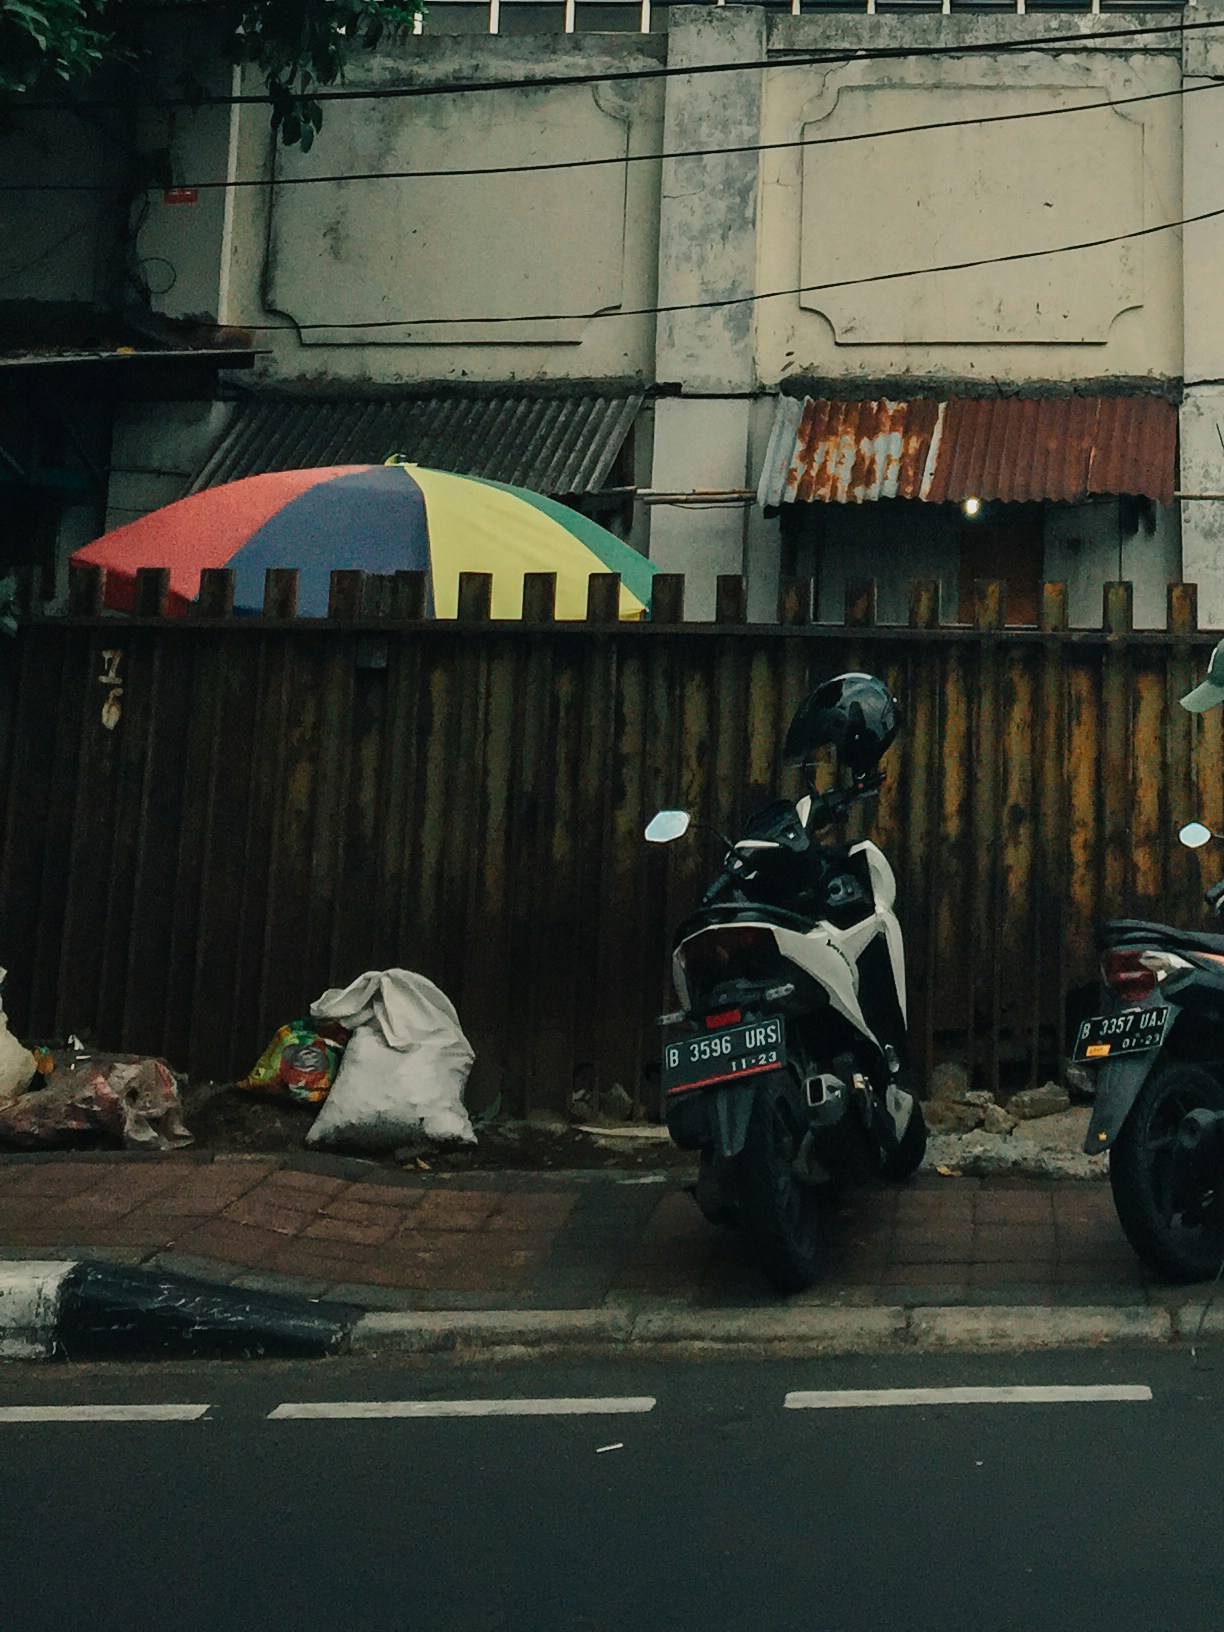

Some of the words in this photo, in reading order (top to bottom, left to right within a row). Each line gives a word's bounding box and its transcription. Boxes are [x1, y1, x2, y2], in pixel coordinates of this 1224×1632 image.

[1081, 1023, 1091, 1040] B
[1099, 1015, 1135, 1036] 3357
[1140, 1009, 1167, 1029] UAJ
[669, 1049, 679, 1068] B
[689, 1036, 731, 1062] 3596
[745, 1025, 777, 1049] URS
